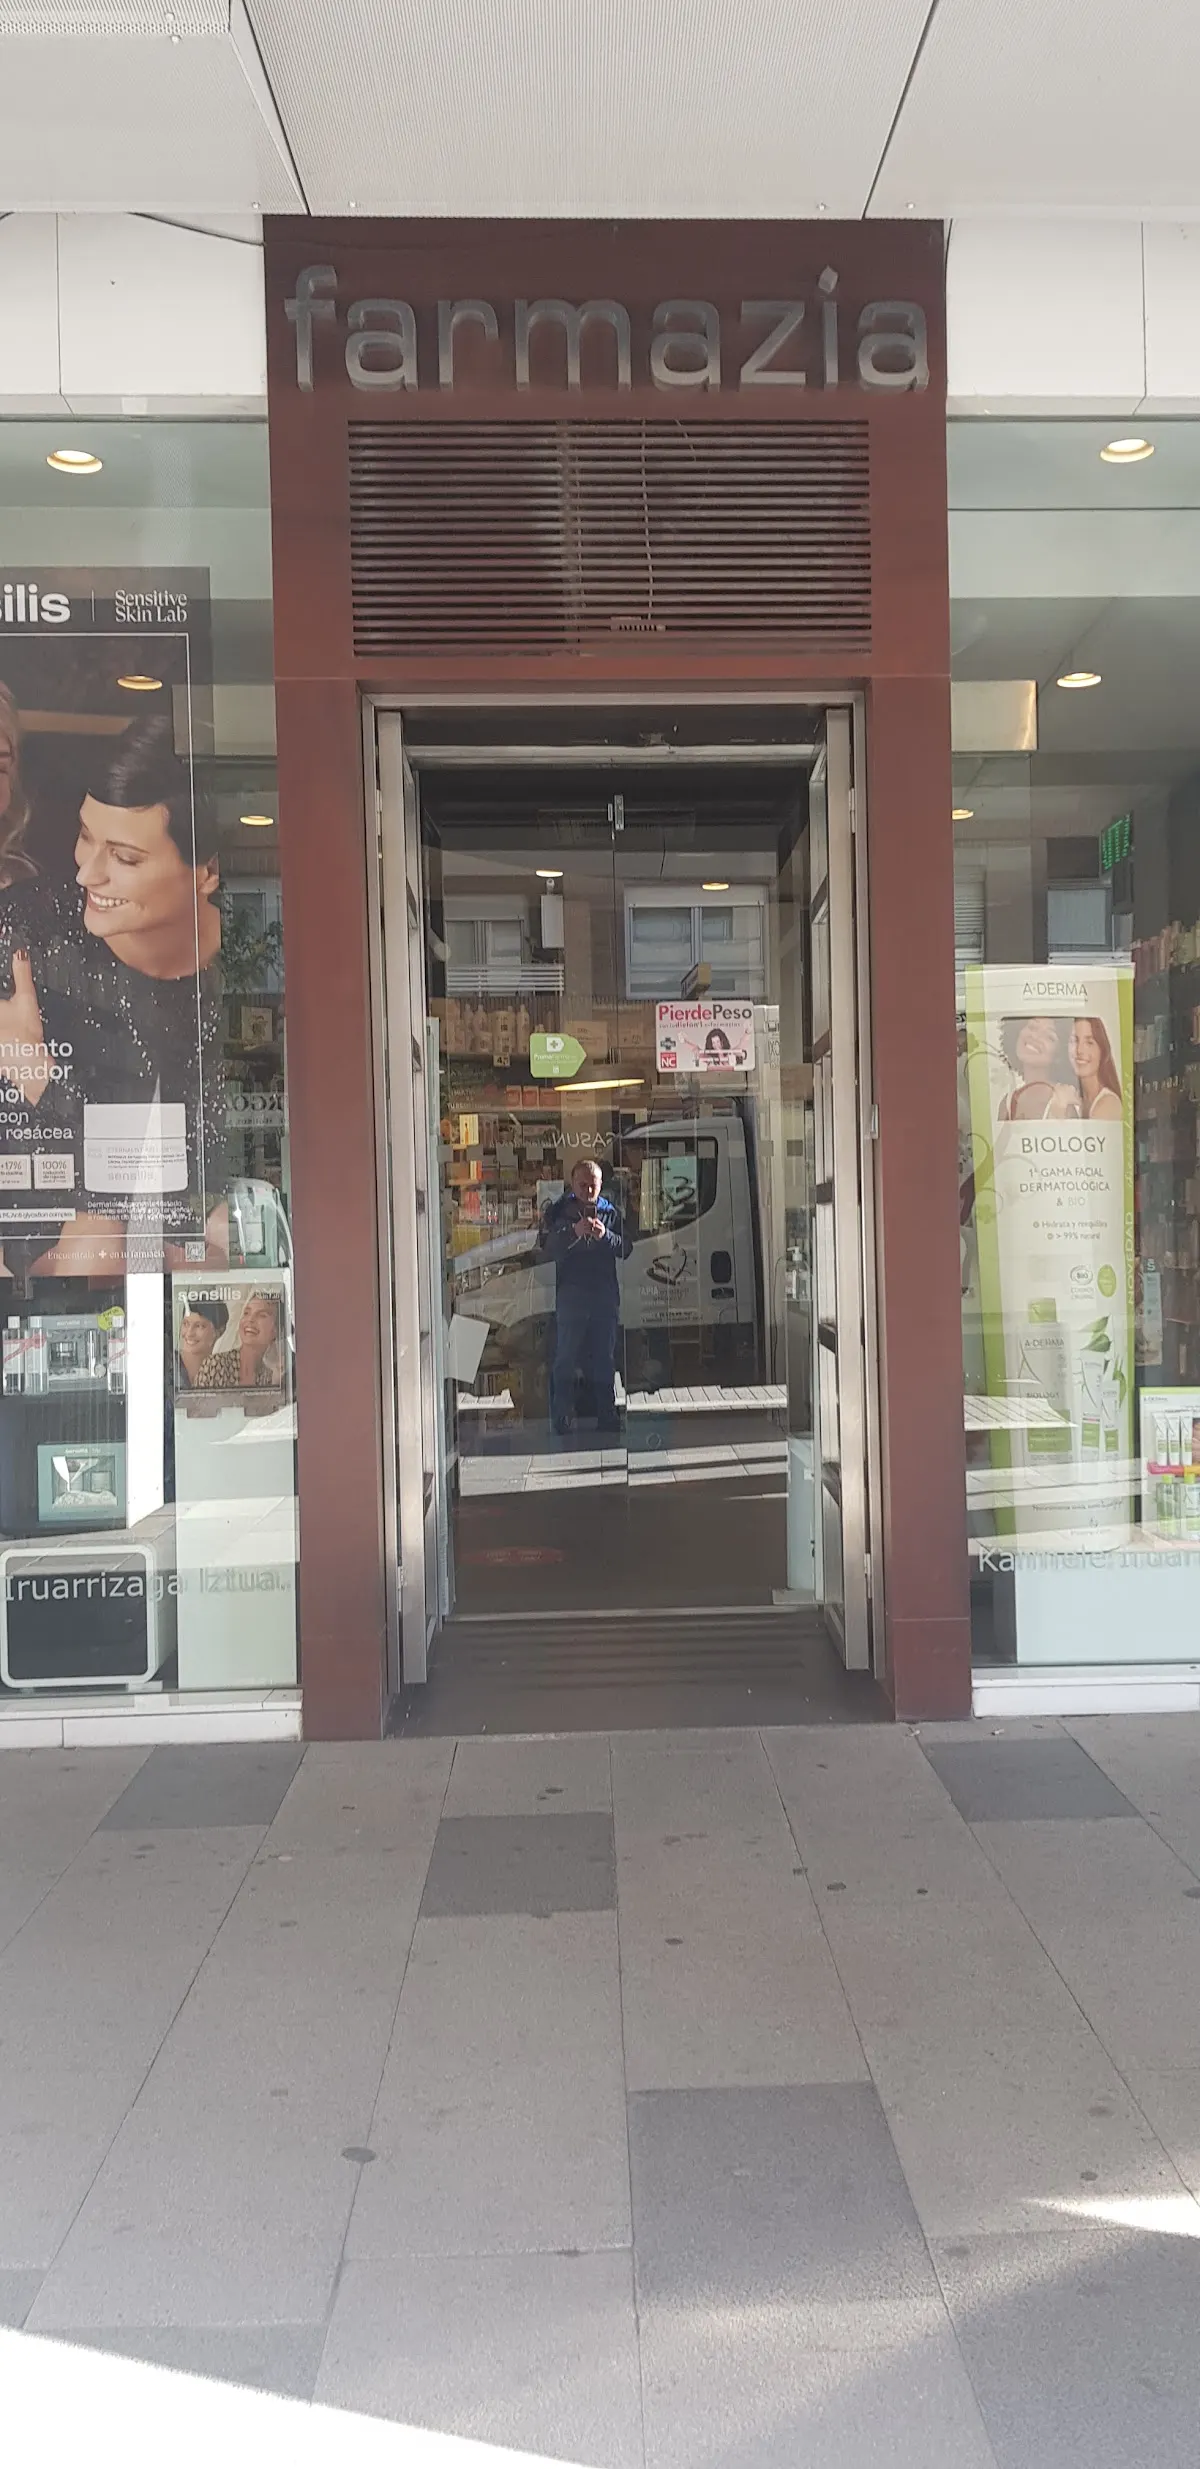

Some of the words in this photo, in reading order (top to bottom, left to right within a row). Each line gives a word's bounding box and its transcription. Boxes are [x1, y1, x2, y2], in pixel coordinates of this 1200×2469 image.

[284, 264, 929, 392] farmazia
[0, 584, 71, 624] ilis
[115, 589, 188, 607] Sensitive
[115, 605, 153, 623] Skin
[156, 605, 188, 623] Lab
[658, 1004, 753, 1021] PierdePeso
[661, 1057, 677, 1067] NC
[5, 1125, 73, 1140] rosácea
[1021, 1136, 1106, 1154] BIOLOGY
[1041, 1167, 1073, 1178] GAMA
[1075, 1167, 1104, 1178] FACIAL
[1019, 1179, 1110, 1193] DERMATOLÓGICA
[1067, 1197, 1086, 1206] BIO
[1124, 1212, 1134, 1305] NOVEDAD
[178, 1286, 242, 1302] sensilis
[4, 1571, 185, 1601] Iruarrizaga
